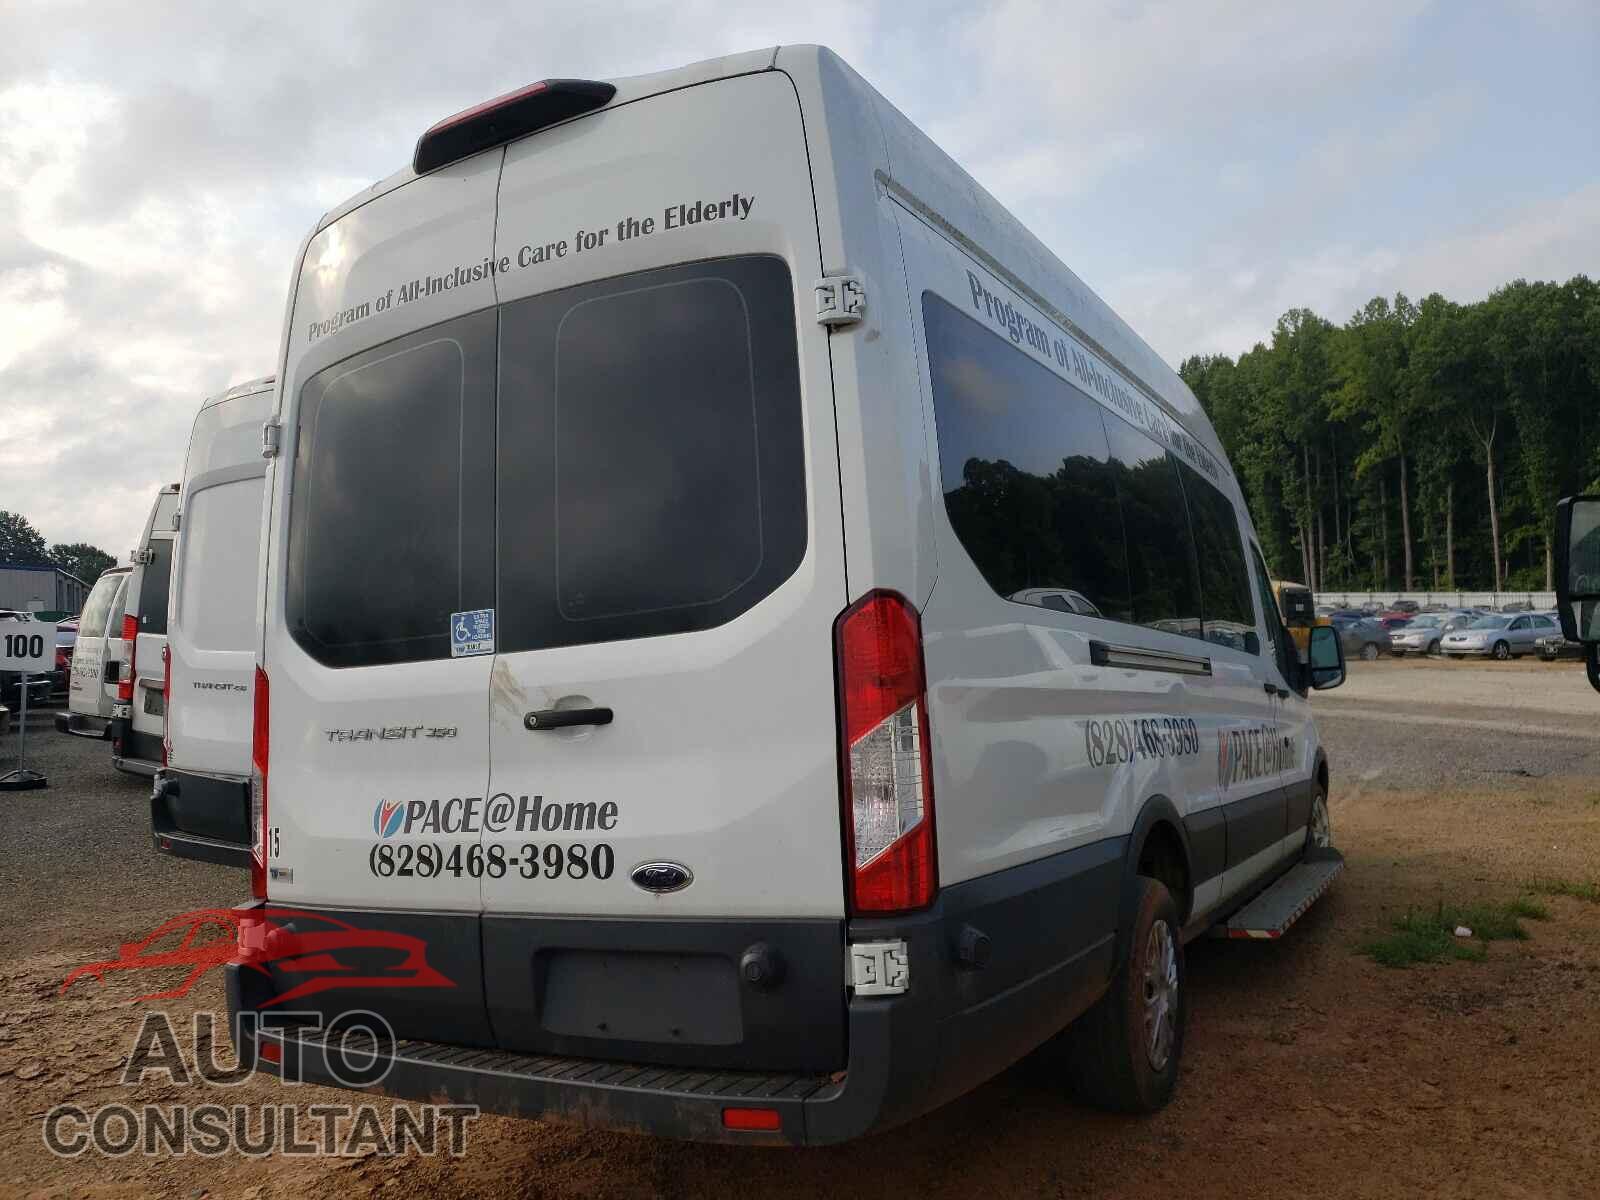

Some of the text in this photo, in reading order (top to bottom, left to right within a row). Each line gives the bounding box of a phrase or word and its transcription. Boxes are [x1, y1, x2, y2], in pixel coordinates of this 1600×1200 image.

[308, 193, 755, 341] Program of All-Inclusive Care for the Elderly
[966, 269, 1052, 358] Program
[1053, 338, 1070, 371] of
[4, 634, 44, 659] 100
[324, 724, 424, 742] TRANSIT
[1085, 717, 1200, 768] (828)468-3980
[403, 792, 619, 834] PACE@Home
[269, 827, 280, 858] 15
[369, 843, 615, 880] (828)468-3980
